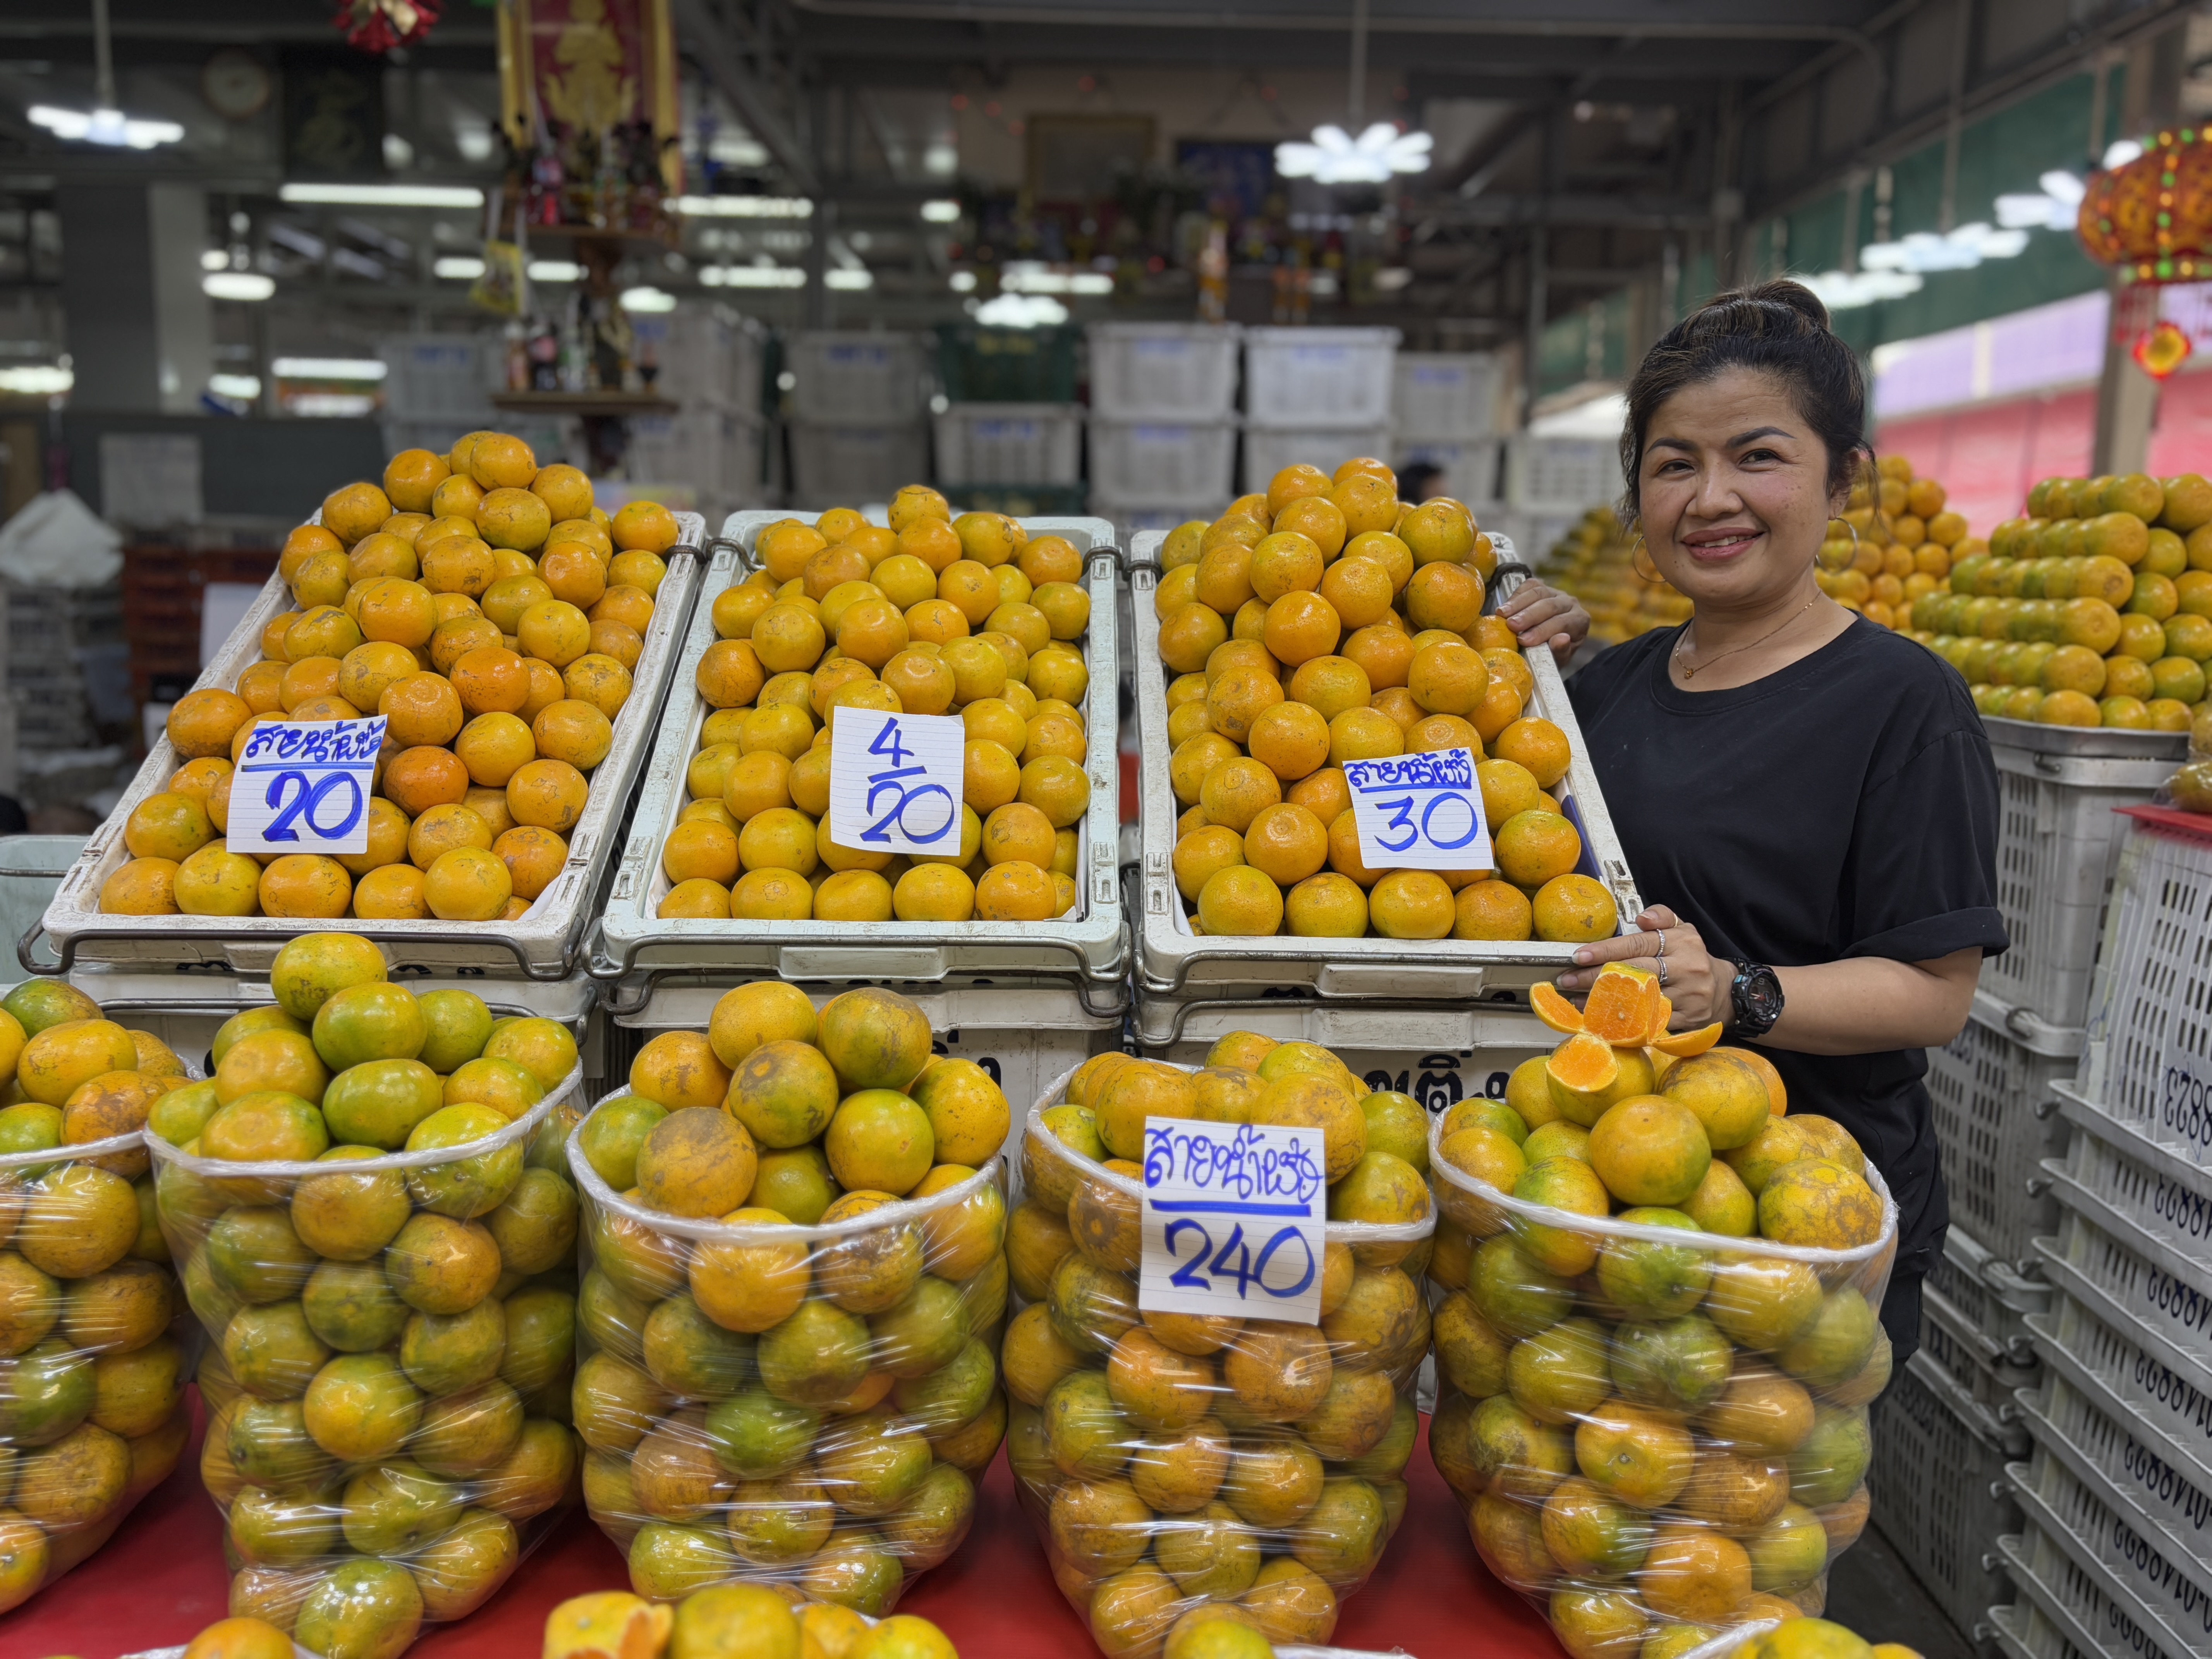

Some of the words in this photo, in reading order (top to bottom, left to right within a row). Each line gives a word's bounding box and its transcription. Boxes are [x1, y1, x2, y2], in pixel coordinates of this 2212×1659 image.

[867, 717, 914, 768] 4
[261, 771, 363, 842] 20
[860, 780, 955, 844] 20
[1374, 792, 1478, 852] 30
[1164, 1218, 1316, 1300] 240
